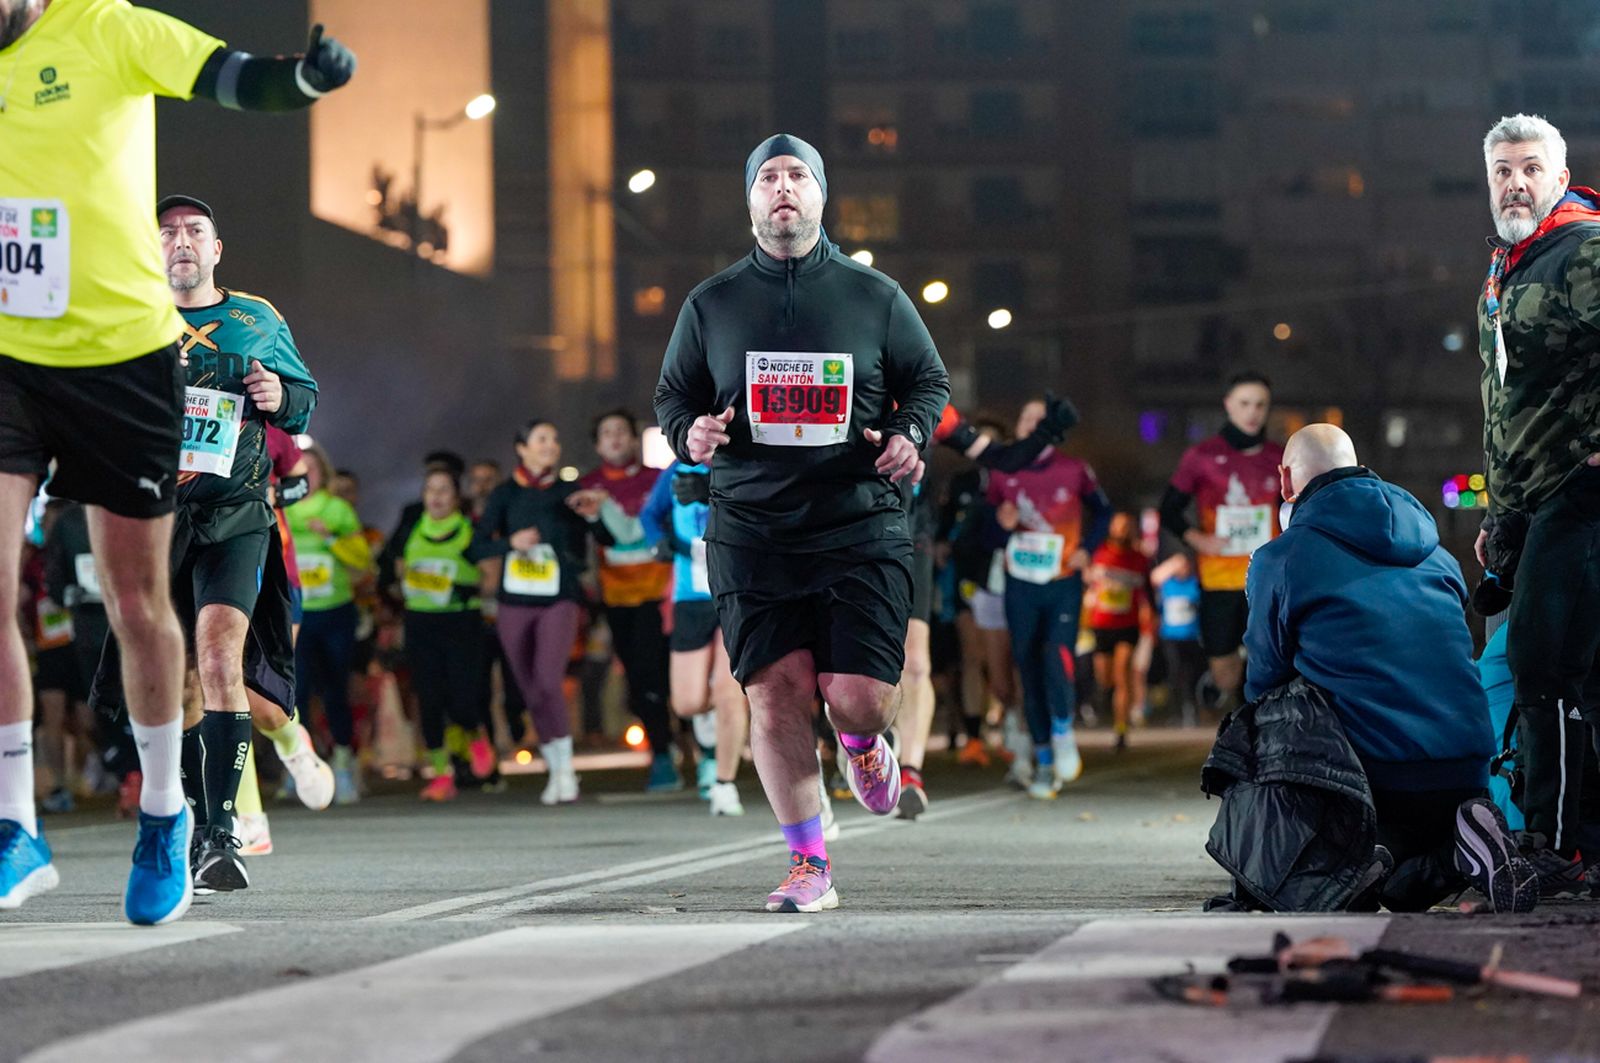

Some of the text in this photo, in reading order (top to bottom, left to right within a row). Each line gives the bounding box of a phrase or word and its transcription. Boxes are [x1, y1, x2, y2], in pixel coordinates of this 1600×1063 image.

[0, 242, 44, 275] 04
[770, 363, 815, 372] NOCHE DE
[758, 373, 779, 383] SAN
[781, 372, 815, 384] ANTÓN
[199, 398, 209, 406] DE
[758, 386, 840, 414] 13909
